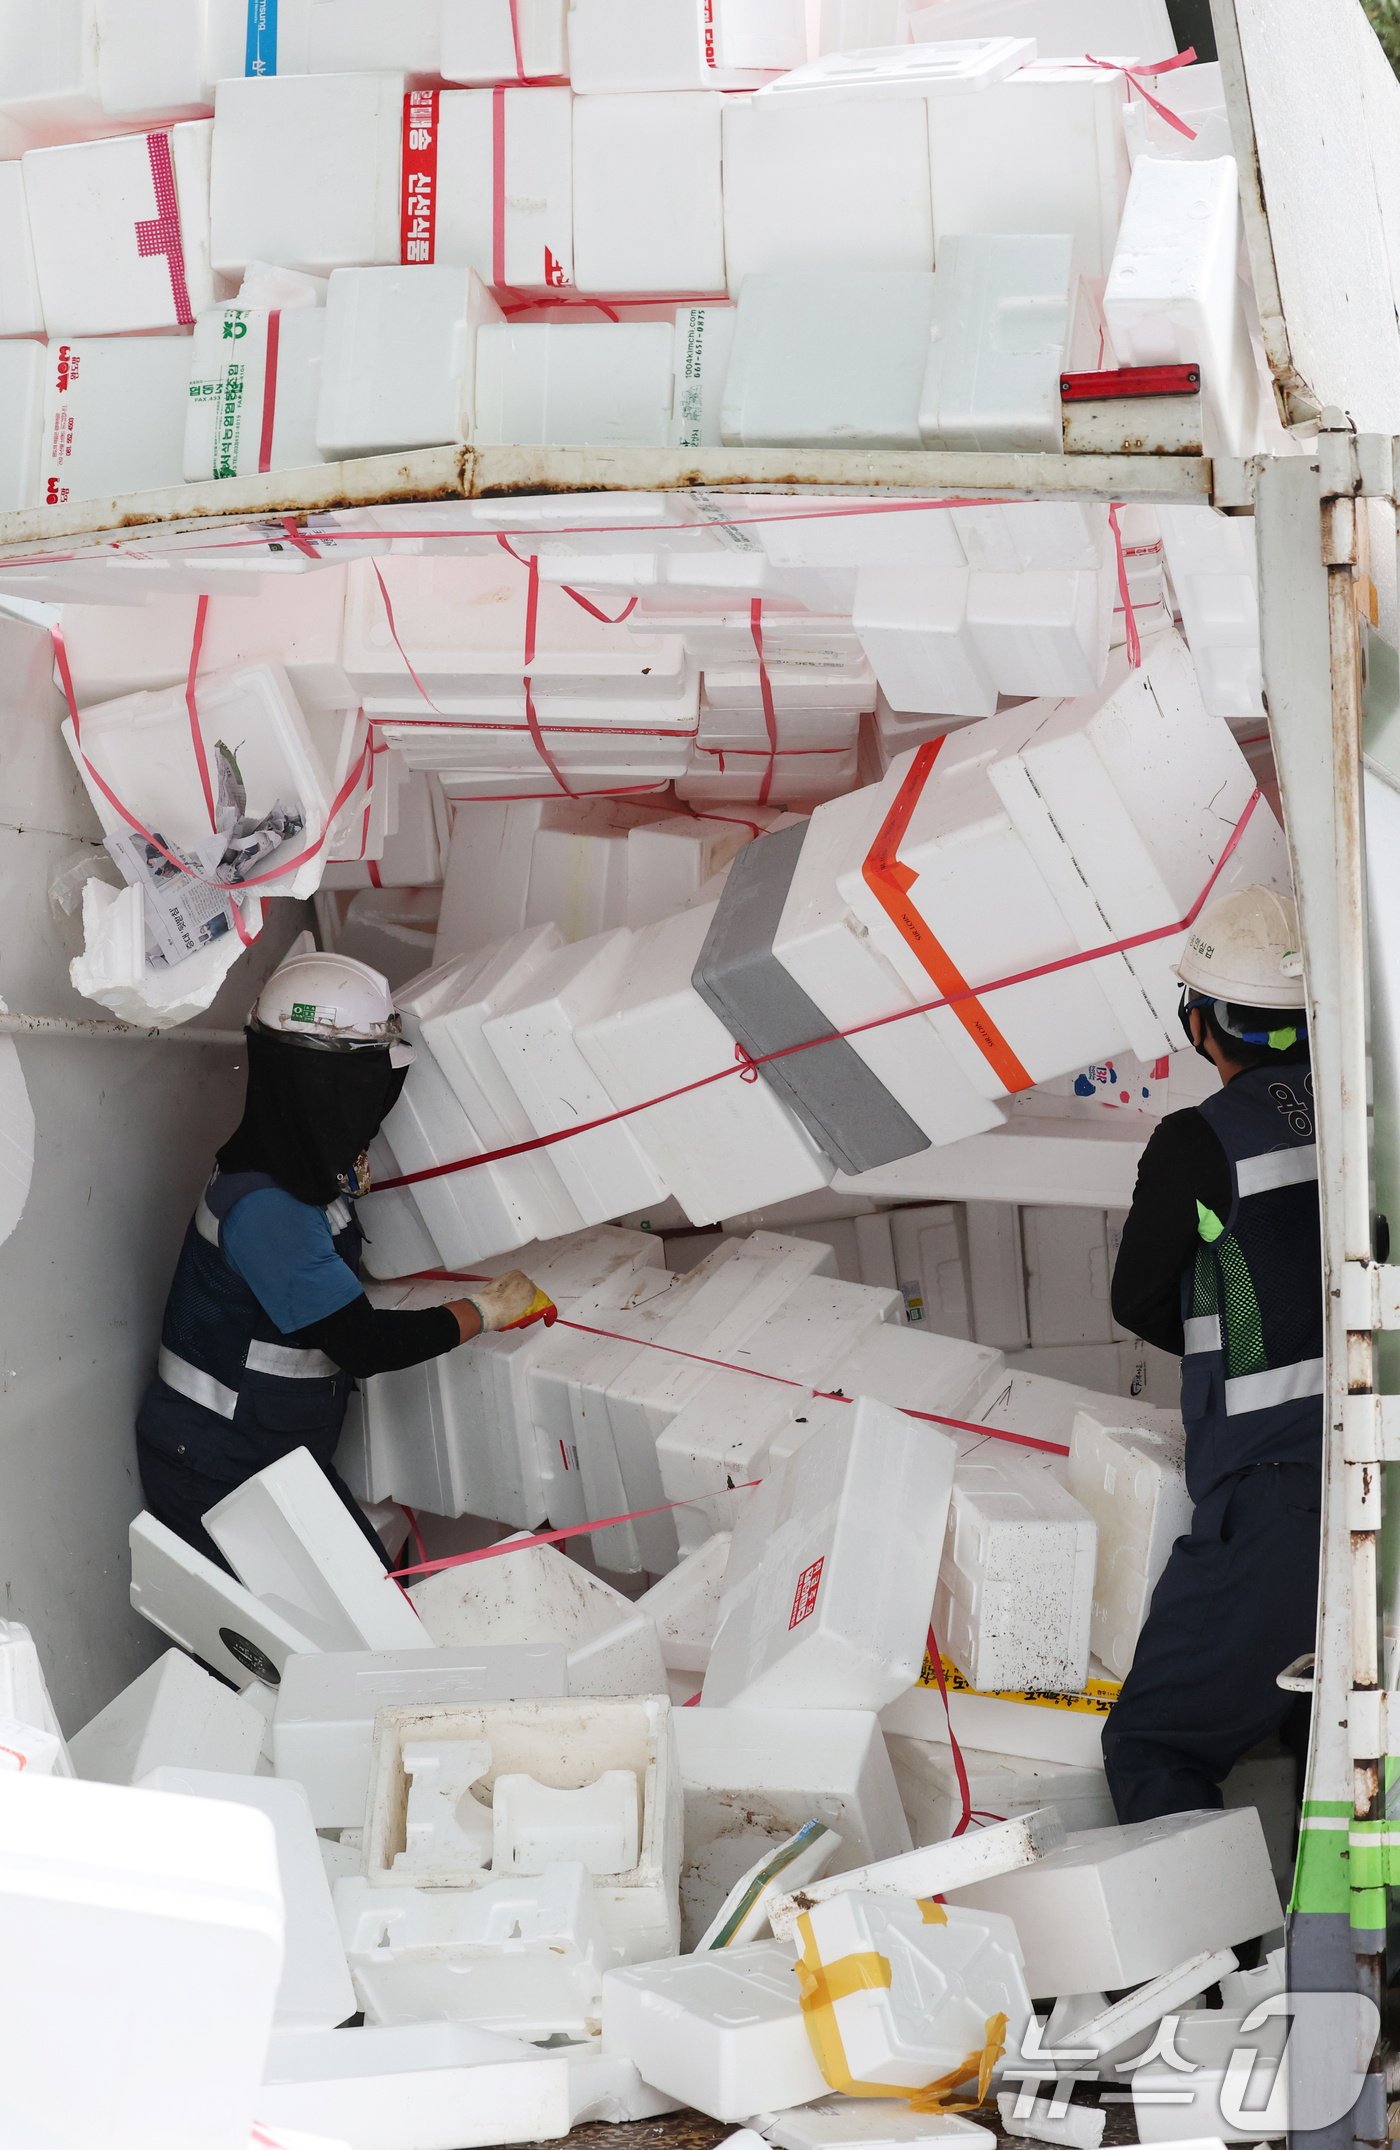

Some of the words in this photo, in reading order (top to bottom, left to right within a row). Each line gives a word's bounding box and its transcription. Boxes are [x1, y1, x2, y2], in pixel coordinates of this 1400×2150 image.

[407, 172, 432, 262] 신선식품
[70, 357, 80, 380] 완도맘
[685, 309, 697, 378] 1004kimchi.com
[694, 310, 704, 378] 061-651-0875
[901, 913, 923, 942] SIR.LOIN
[973, 1020, 996, 1049] SIR.LOIN
[804, 1559, 823, 1618] 취급주의
